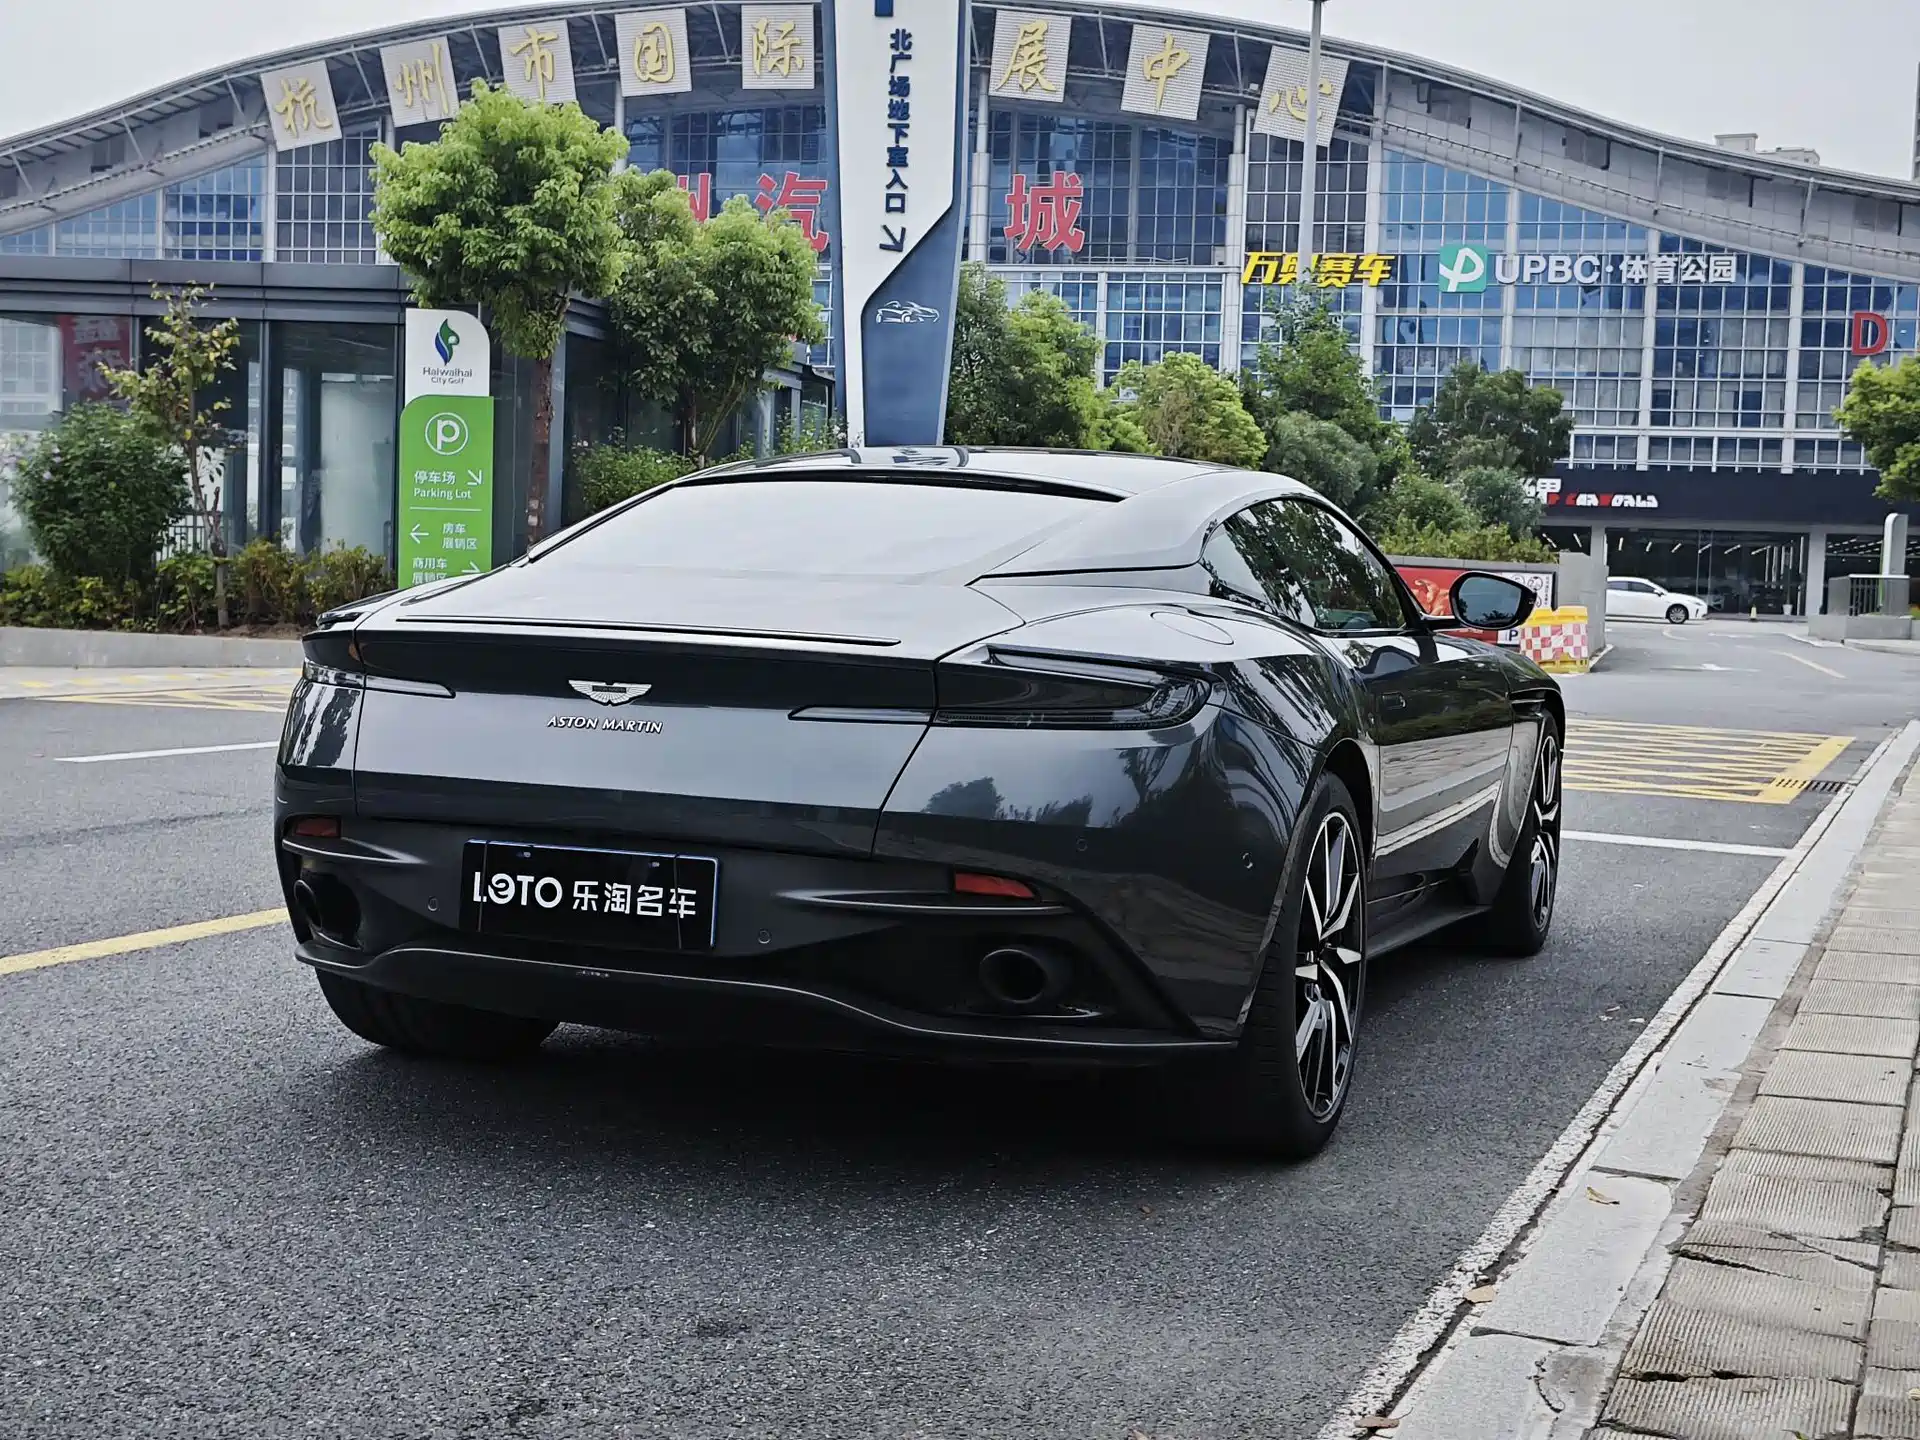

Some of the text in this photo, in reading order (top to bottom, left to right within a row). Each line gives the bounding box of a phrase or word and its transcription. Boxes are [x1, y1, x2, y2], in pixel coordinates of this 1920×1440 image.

[885, 29, 913, 213] 北广场地下室入口
[1851, 311, 1888, 356] D
[422, 367, 473, 378] Haiwaihai
[430, 377, 465, 385] City Golf
[414, 470, 456, 485] 停车场
[413, 487, 472, 500] Parking Lot
[442, 523, 466, 535] 房车
[442, 537, 478, 550] 展销区
[412, 557, 448, 570] 商用车
[547, 715, 663, 734] ASTON MARTIN
[572, 880, 697, 919] 乐淘名车
